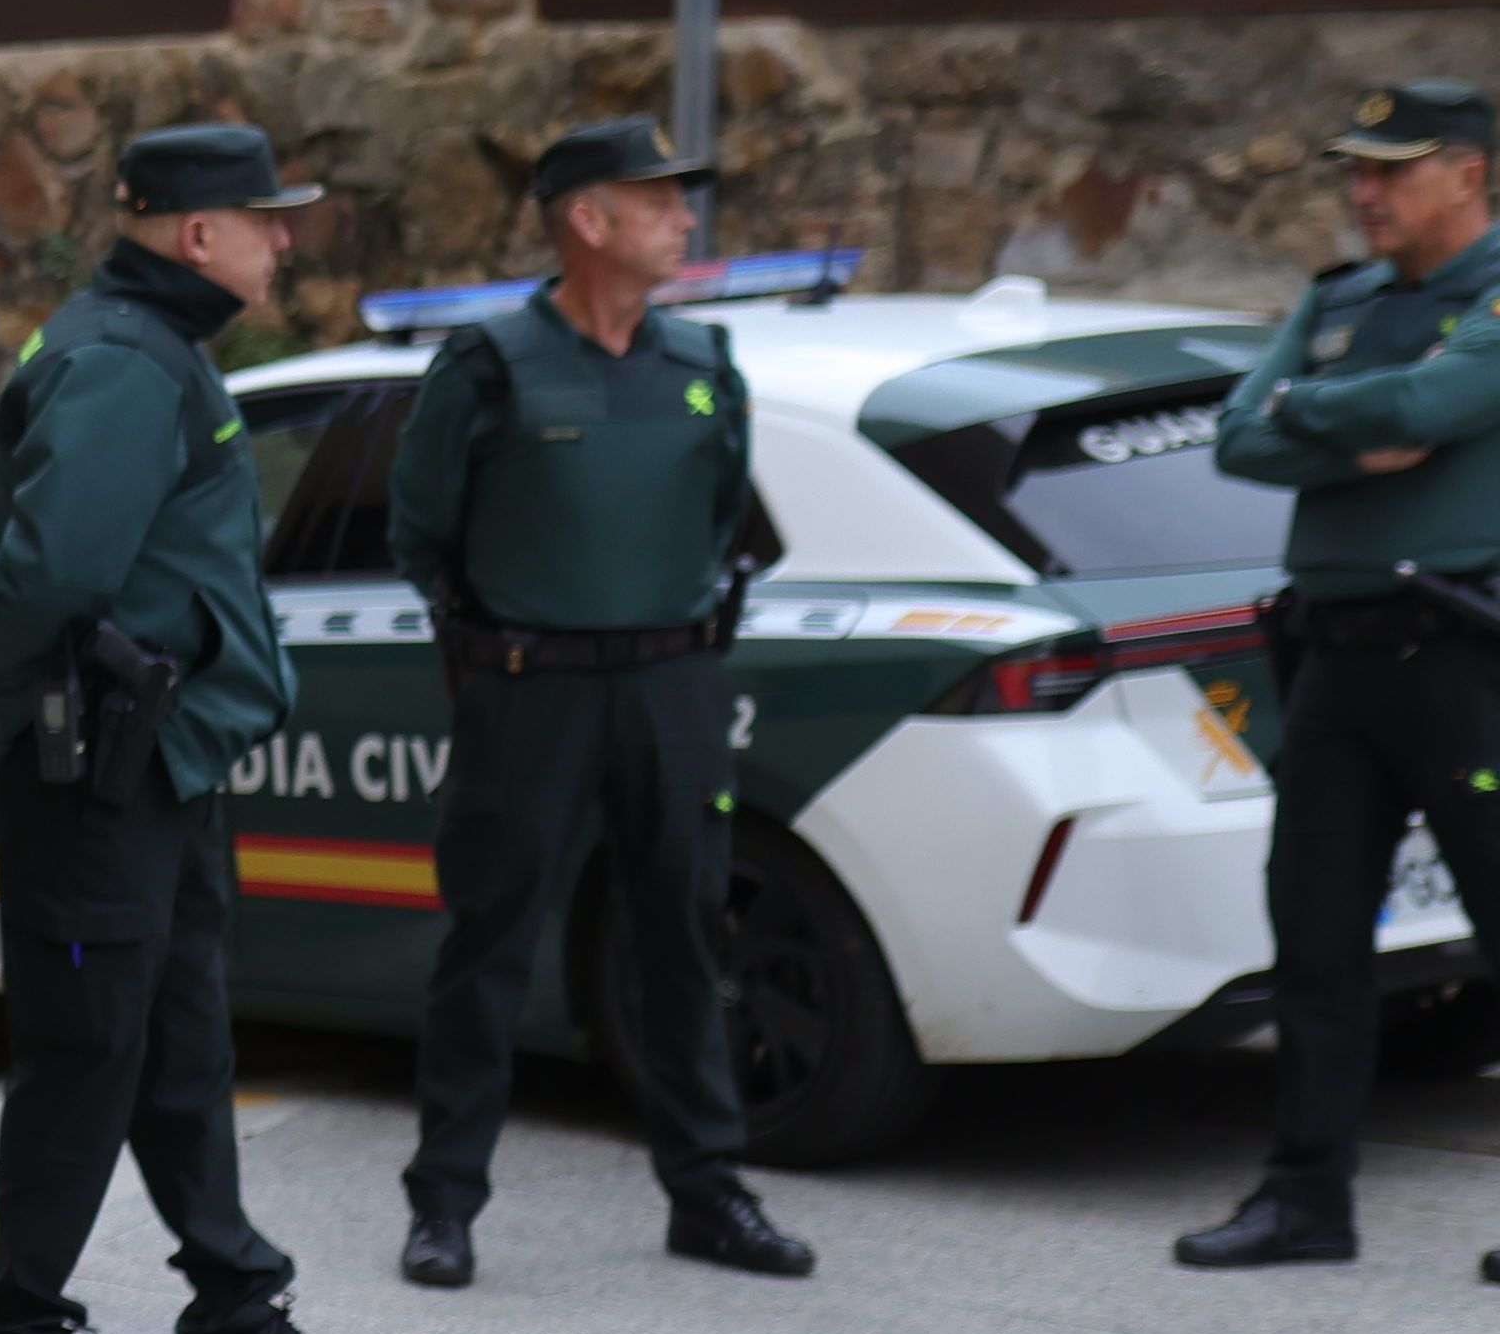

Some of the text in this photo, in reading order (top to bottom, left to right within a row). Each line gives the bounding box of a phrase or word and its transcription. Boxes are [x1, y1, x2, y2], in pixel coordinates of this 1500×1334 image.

[1078, 405, 1222, 463] GUAR
[216, 731, 452, 803] DIA CIV
